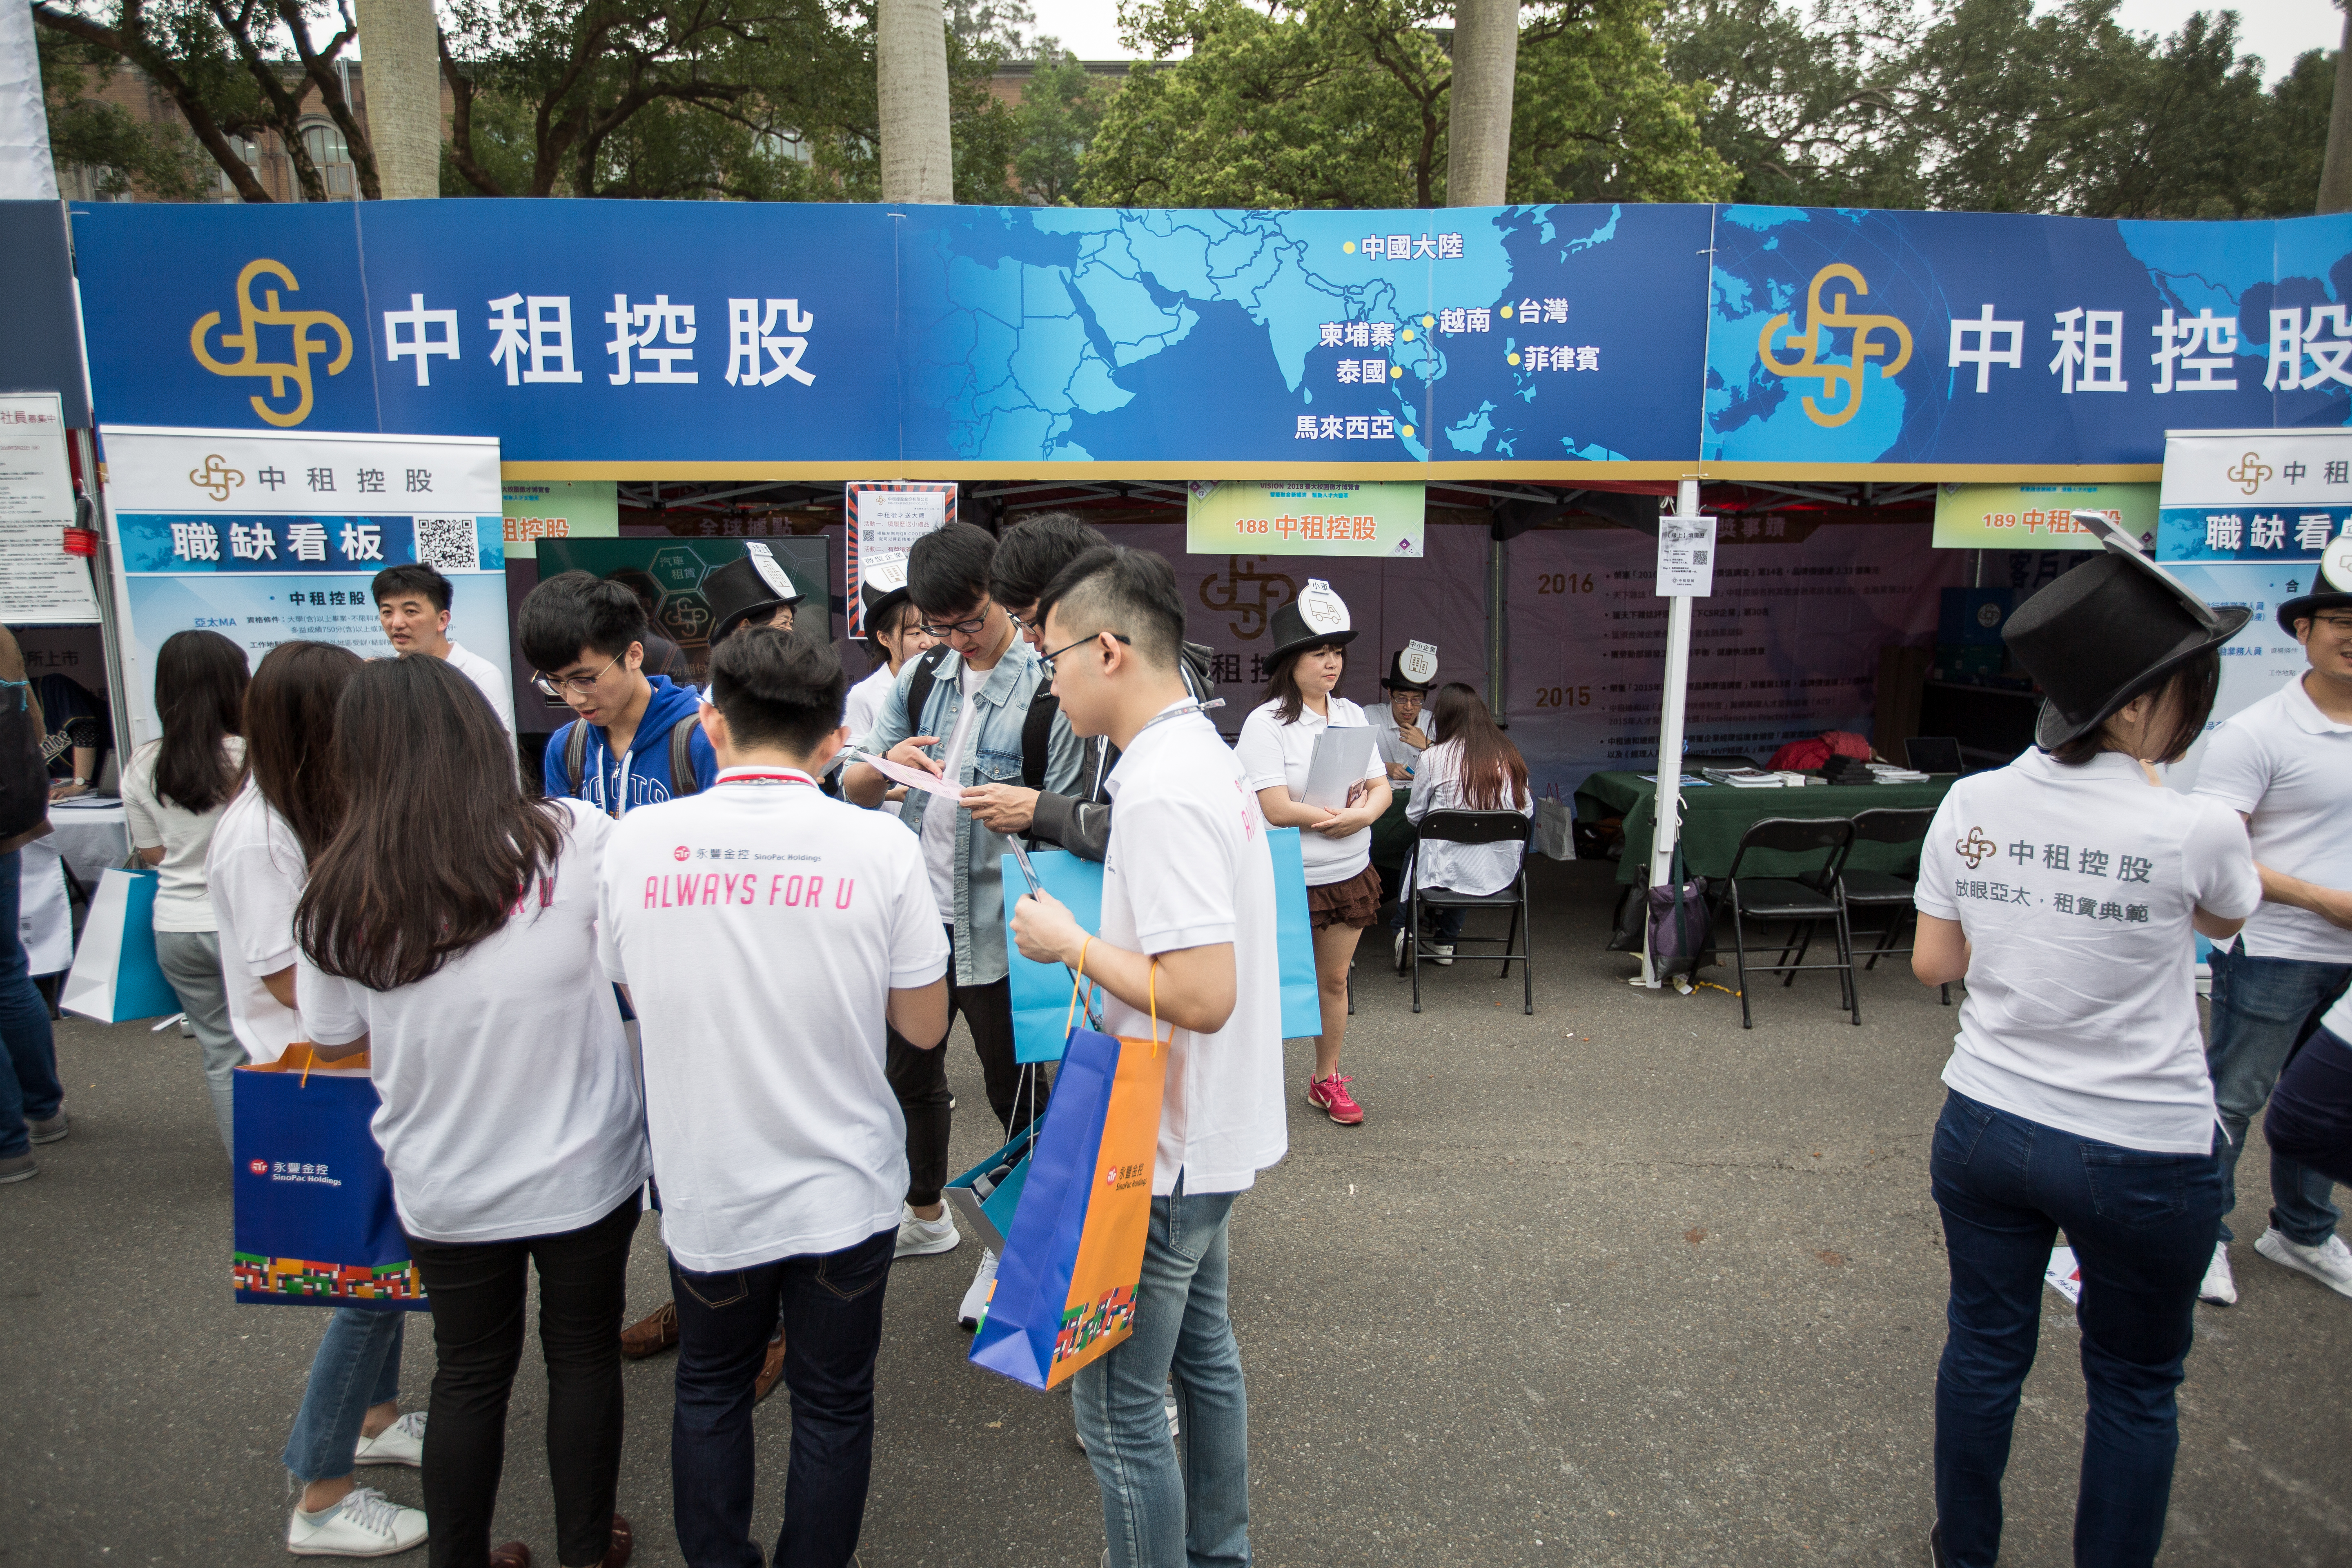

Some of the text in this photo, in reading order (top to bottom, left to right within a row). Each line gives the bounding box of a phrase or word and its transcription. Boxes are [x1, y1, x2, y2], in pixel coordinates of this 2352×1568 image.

[1361, 232, 1464, 261] 中國大陸
[1439, 307, 1491, 334] 越南
[1518, 298, 1569, 324] 台灣
[384, 291, 817, 389] 中租控股
[1319, 321, 1395, 348] 柬埔寨
[1524, 345, 1600, 372] 菲律賓
[1947, 304, 2352, 394] 中租控股
[1336, 358, 1386, 385] 泰國
[1294, 415, 1395, 440] 馬來西亞
[259, 466, 434, 493] 中租控股
[1235, 514, 1377, 541] 188 中租控股
[1982, 513, 2016, 529] 189
[171, 522, 384, 562] 職缺看板
[1312, 581, 1329, 591] 小車
[1537, 573, 1593, 595] 2016
[290, 591, 365, 606] 中租控股
[23, 650, 78, 667] 所上市
[1410, 641, 1436, 653] 中小企業
[1536, 686, 1591, 707] 2015
[696, 848, 750, 860] 永豐金控
[788, 853, 822, 862] Holdings
[2008, 839, 2153, 884] 中租控股
[644, 873, 855, 909] ALWAYS FOR U
[274, 1162, 328, 1174] 永豐金控
[308, 1175, 342, 1186] Holdings
[1118, 1163, 1144, 1180] 永豐金控
[1116, 1178, 1147, 1191] SinoPac Holdings
